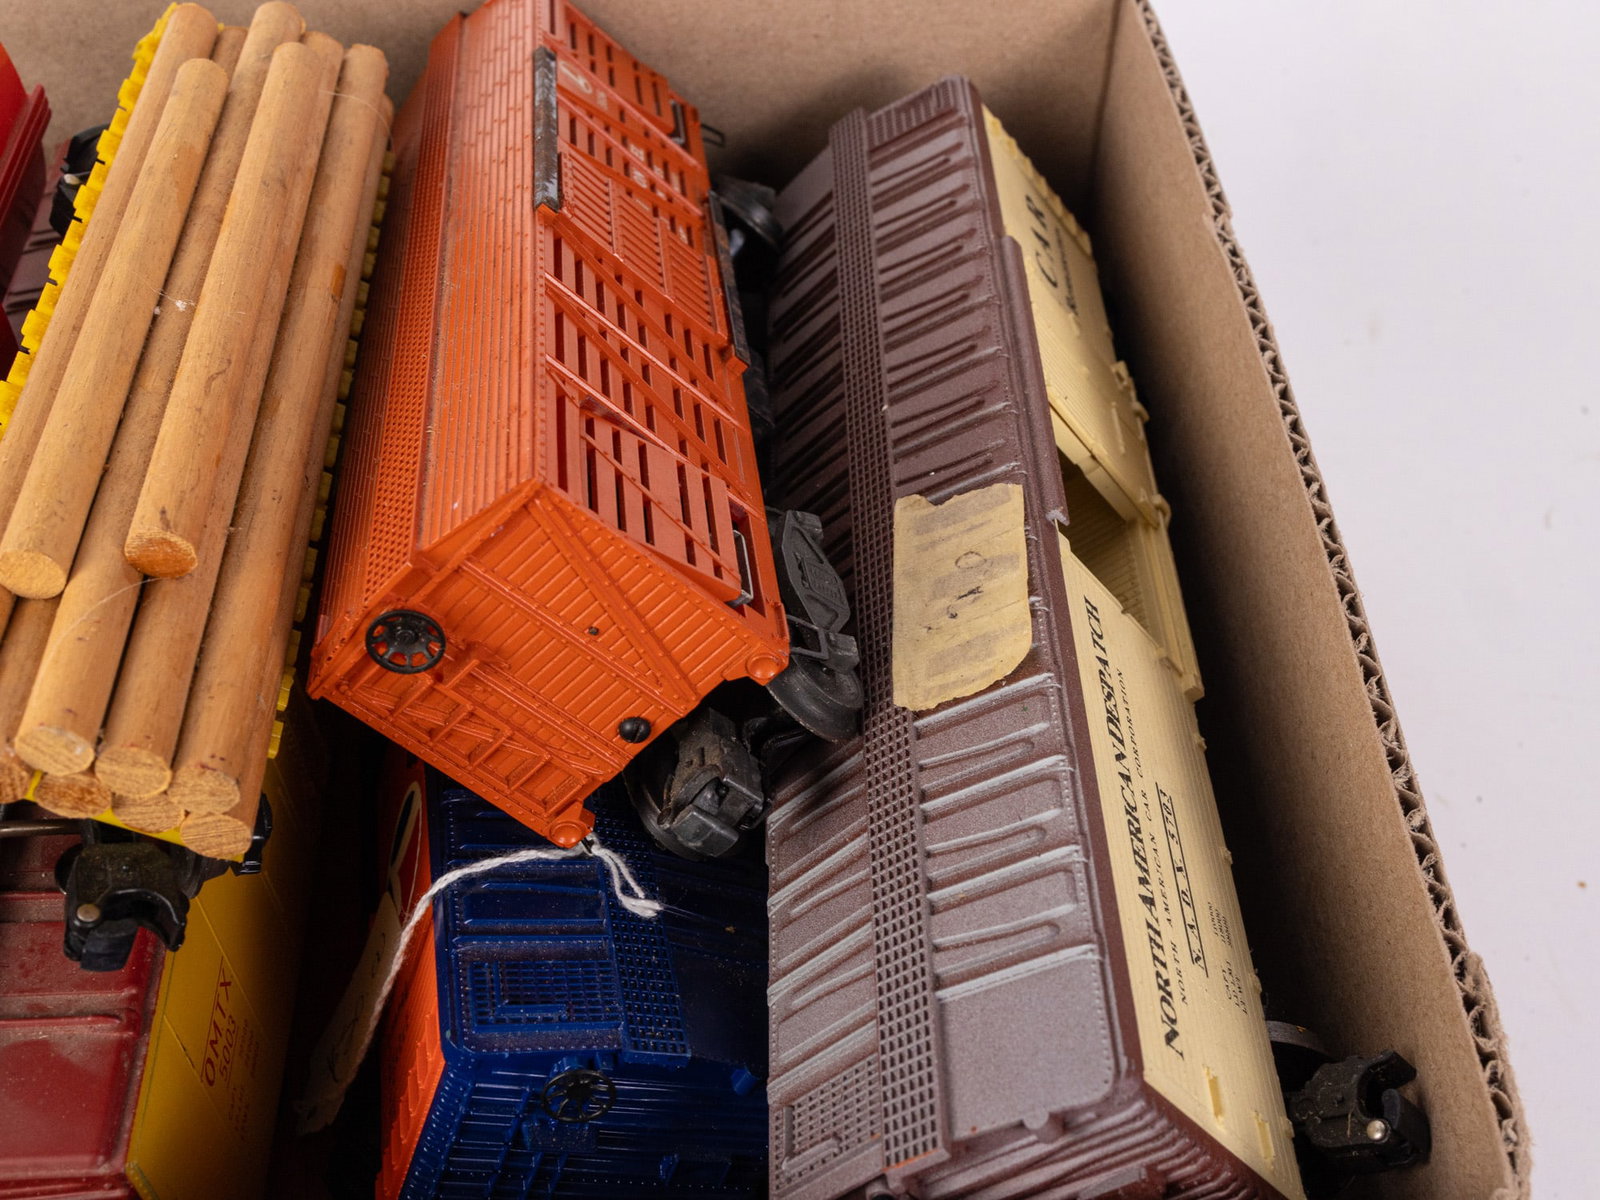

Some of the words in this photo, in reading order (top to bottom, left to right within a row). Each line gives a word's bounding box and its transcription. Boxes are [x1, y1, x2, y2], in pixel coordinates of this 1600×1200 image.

[1083, 595, 1126, 751] DESPATCH
[1116, 668, 1144, 779] CORPORATION
[1112, 743, 1159, 921] AMERICAN
[1141, 789, 1153, 822] CAR
[1159, 789, 1180, 846] 5703
[1149, 833, 1173, 928] AMERICAN
[1145, 918, 1184, 1060] NORTH
[1171, 942, 1189, 1006] NORTH
[204, 967, 232, 1088] OMTX
[219, 1014, 238, 1082] 5003
